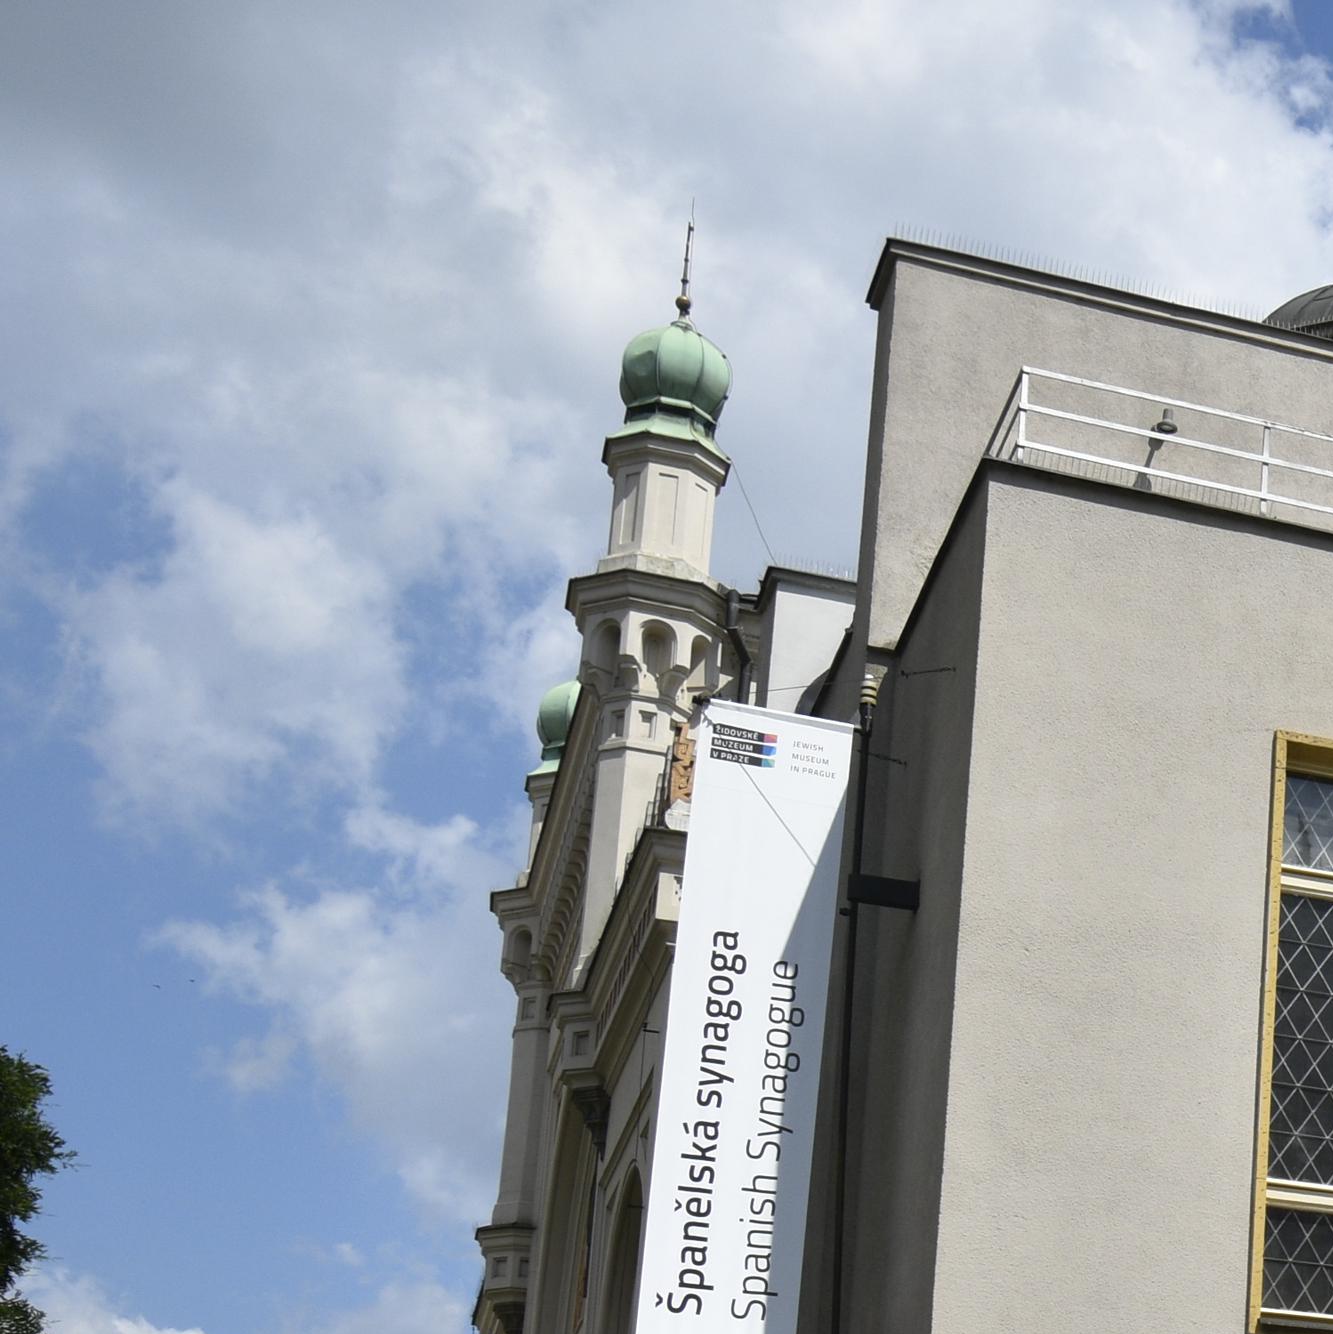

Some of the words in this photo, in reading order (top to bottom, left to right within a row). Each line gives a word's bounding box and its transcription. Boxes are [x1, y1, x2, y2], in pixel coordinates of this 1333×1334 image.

[714, 724, 759, 740] ŽIDOVSKÉ
[713, 739, 753, 752] MUZEUM
[792, 740, 824, 752] JEWISH
[720, 753, 750, 764] PRAZE
[791, 753, 830, 765] MUSEUM
[790, 765, 800, 773] IN
[802, 767, 837, 780] PRAGUE
[746, 960, 804, 1162] Synagogue
[655, 1120, 720, 1315] Španělská
[695, 931, 747, 1108] synagoga
[731, 1176, 778, 1321] Spanish
